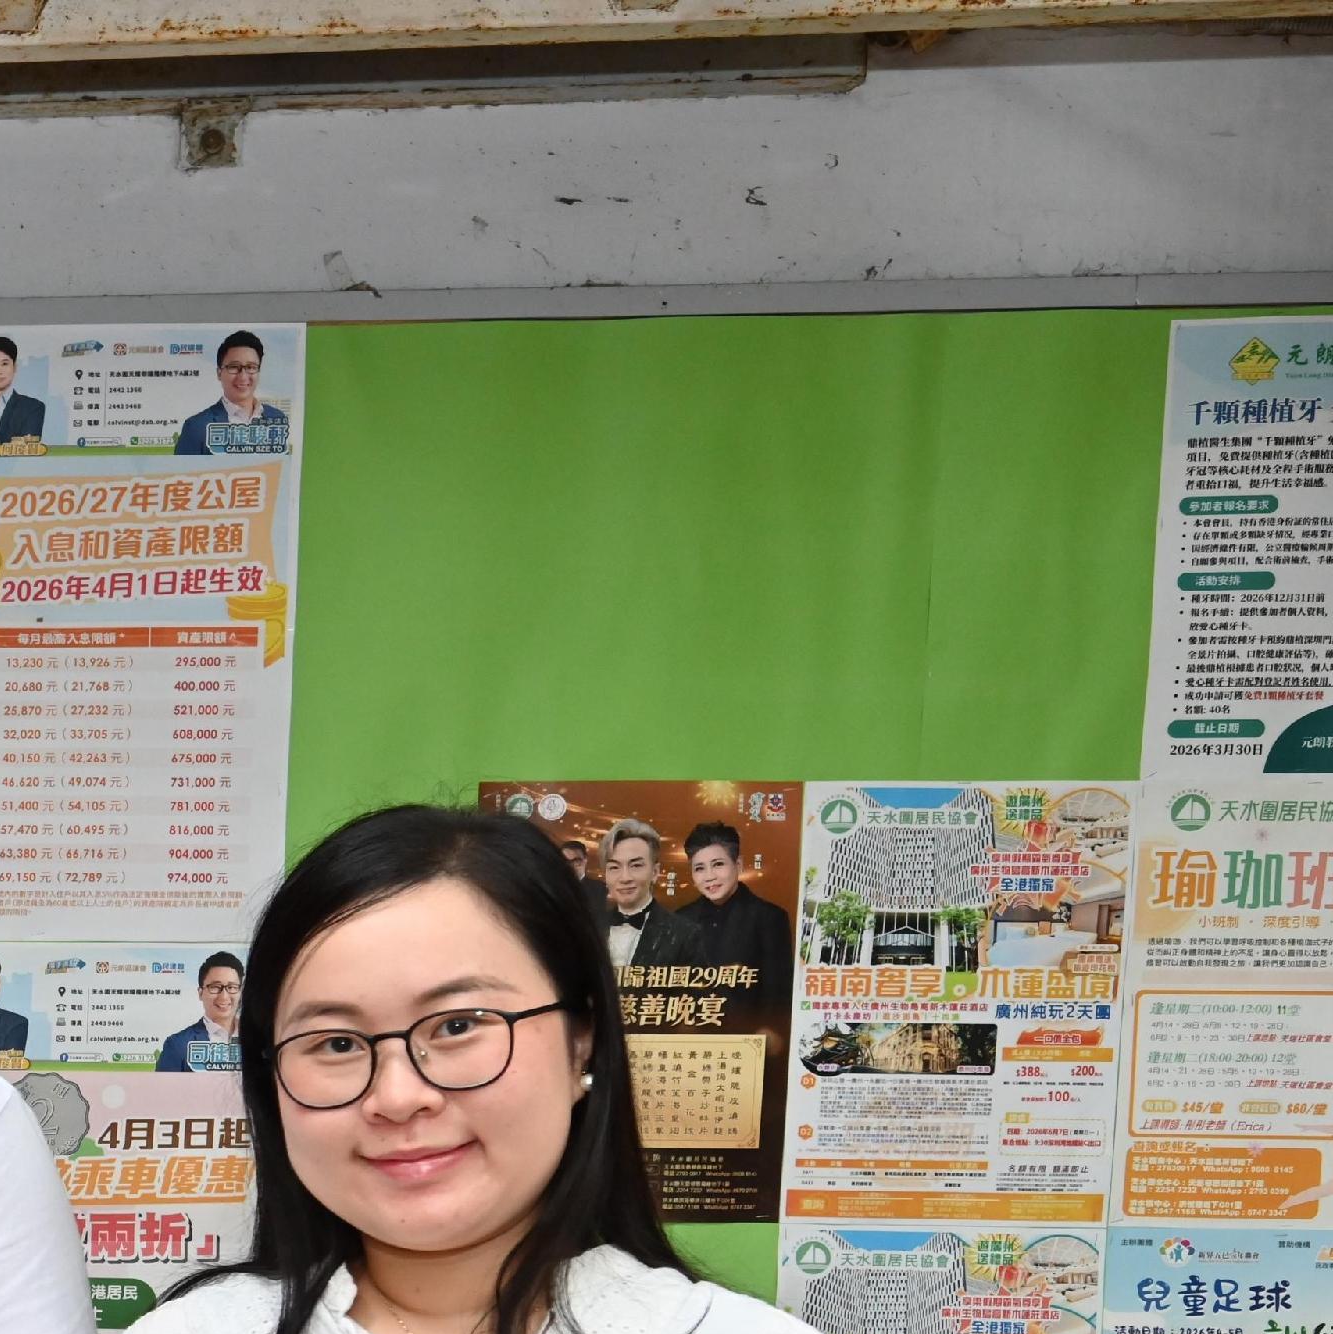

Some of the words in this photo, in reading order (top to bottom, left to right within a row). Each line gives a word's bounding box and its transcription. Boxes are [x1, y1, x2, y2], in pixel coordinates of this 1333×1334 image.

[1185, 398, 1323, 425] 千顆種植牙
[1, 478, 261, 518] 2026/27年度公屋
[1189, 501, 1269, 511] 參加者報名要求
[13, 523, 244, 562] 入息和資產限額
[1, 566, 263, 603] 2026年4月1日起生效
[1196, 576, 1241, 586] 活動安排
[1195, 723, 1239, 734] 截止日期
[1170, 744, 1263, 756] 2026年3月30日
[867, 810, 978, 826] 天水圍居民協會
[1198, 916, 1239, 928] 小班制
[805, 969, 945, 998] 嶺南奢享
[995, 1003, 1111, 1020] 廣州純玩2天團
[98, 1118, 251, 1150] 4月3日起
[75, 1212, 219, 1261] 兩折」
[841, 1252, 950, 1268] 天水圍居民協會
[1137, 1275, 1292, 1316] 兒童足球
